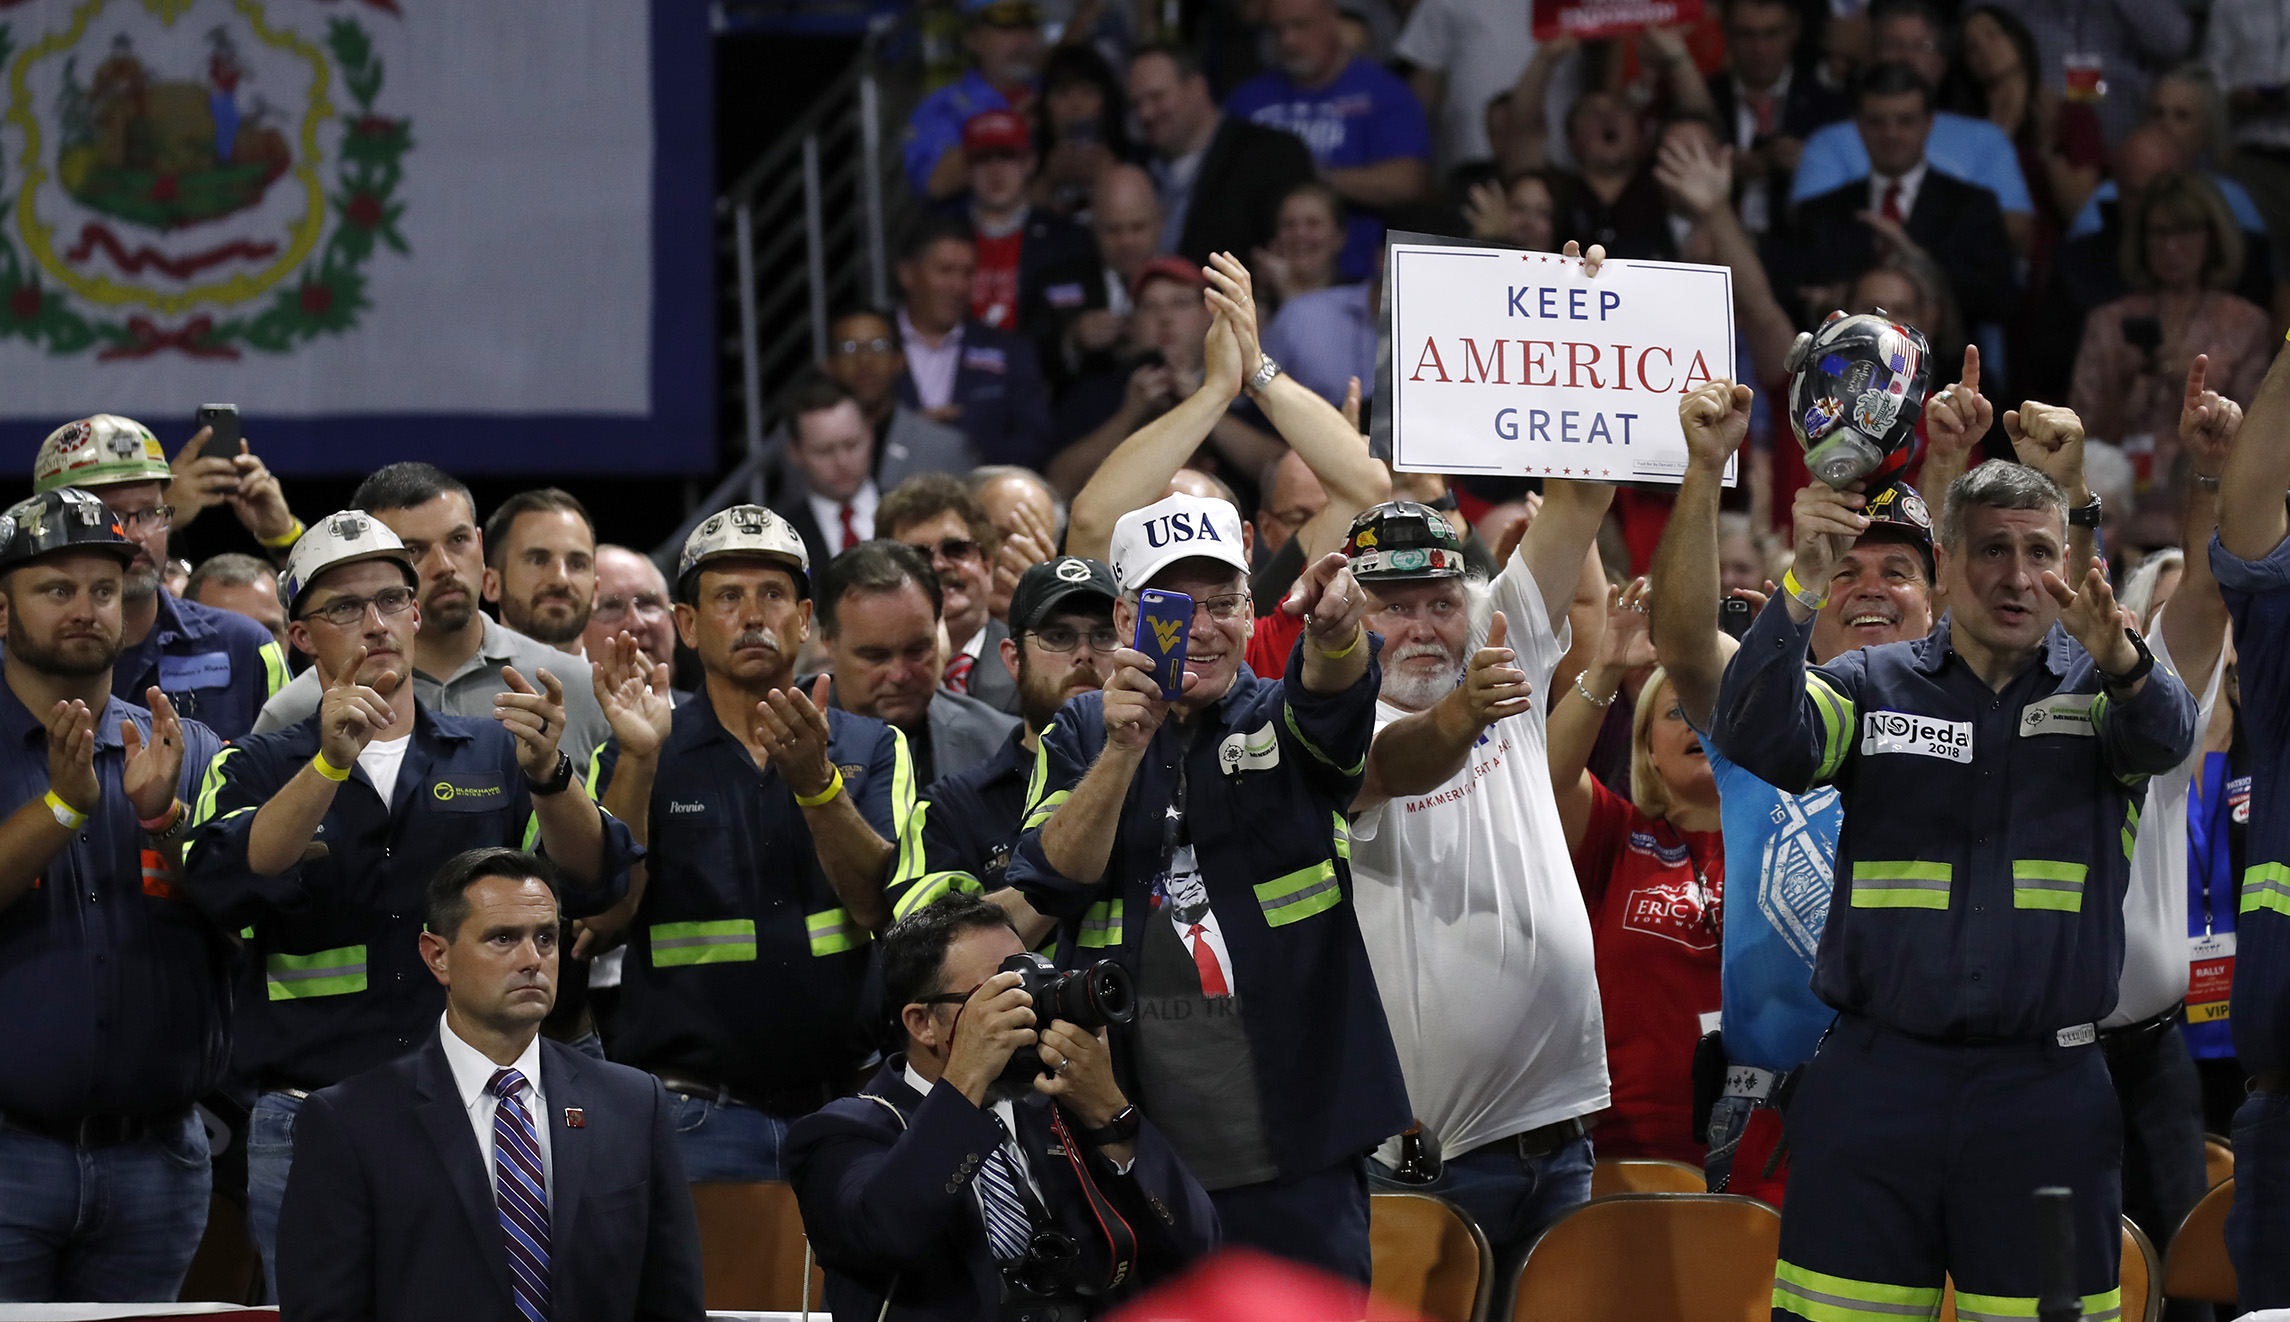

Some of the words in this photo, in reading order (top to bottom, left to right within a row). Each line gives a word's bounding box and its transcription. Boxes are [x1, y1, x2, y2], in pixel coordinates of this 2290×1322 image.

[1508, 286, 1621, 321] KEEP
[1409, 336, 1712, 394] AMERICA
[1495, 408, 1639, 445] GREAT
[1143, 512, 1222, 548] USA
[1928, 742, 1960, 759] 2018
[2226, 776, 2252, 791] PATRIC
[670, 800, 706, 814] Ronnie
[1769, 803, 1787, 825] 19
[1637, 900, 1689, 918] ERIC
[1633, 916, 1662, 925] FOR
[2196, 966, 2225, 978] RALLY
[2205, 1004, 2230, 1018] VIP
